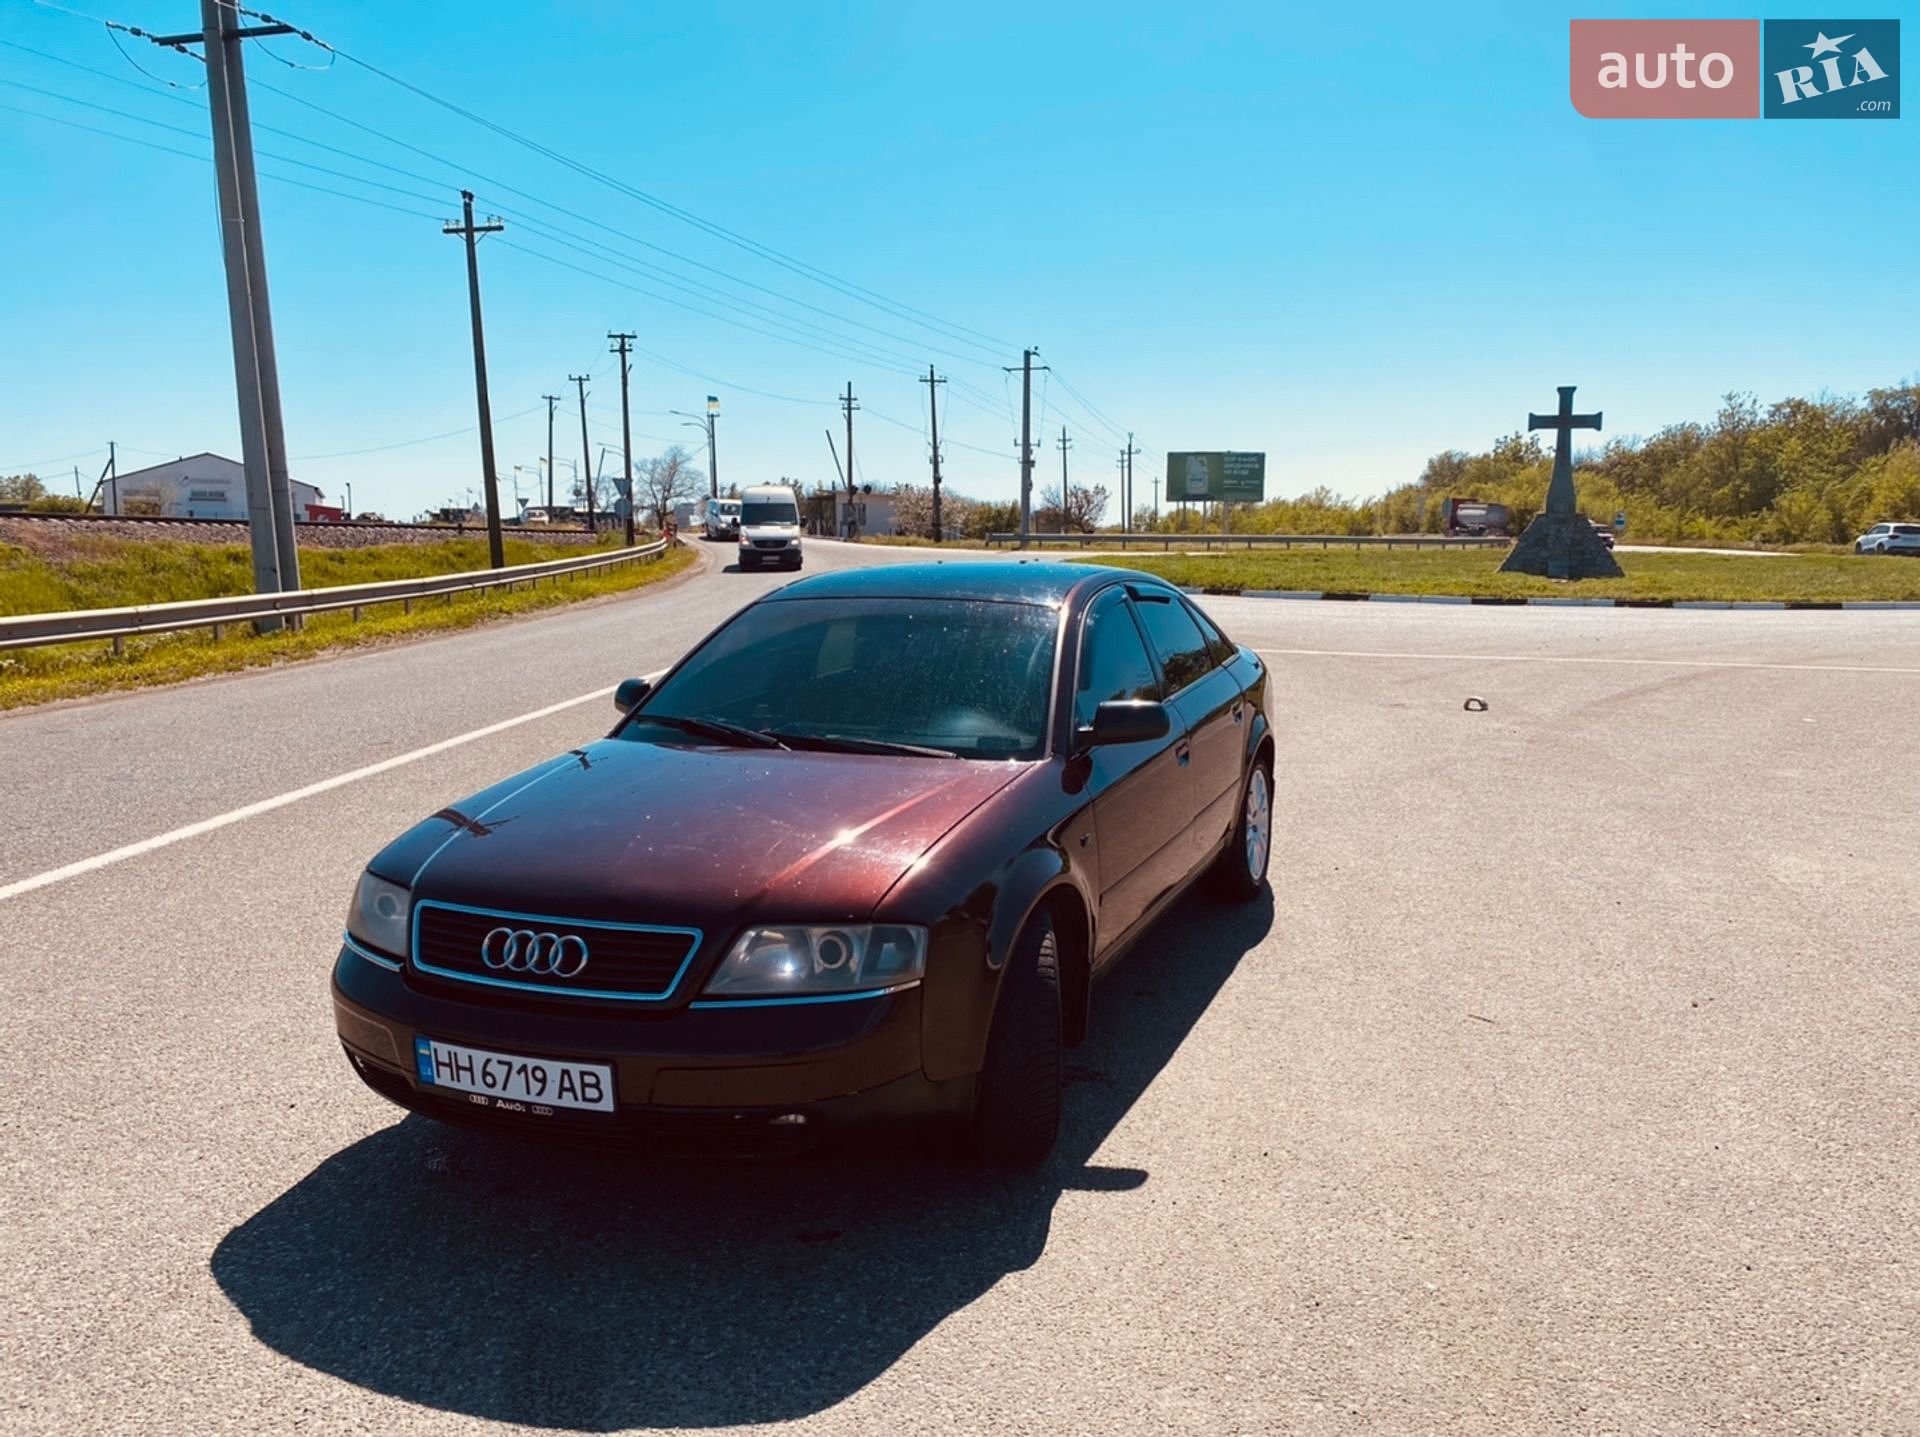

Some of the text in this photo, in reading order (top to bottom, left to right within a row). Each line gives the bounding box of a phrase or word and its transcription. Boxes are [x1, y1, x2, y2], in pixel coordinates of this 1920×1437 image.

[434, 1047, 604, 1104] HH 6719 AB
